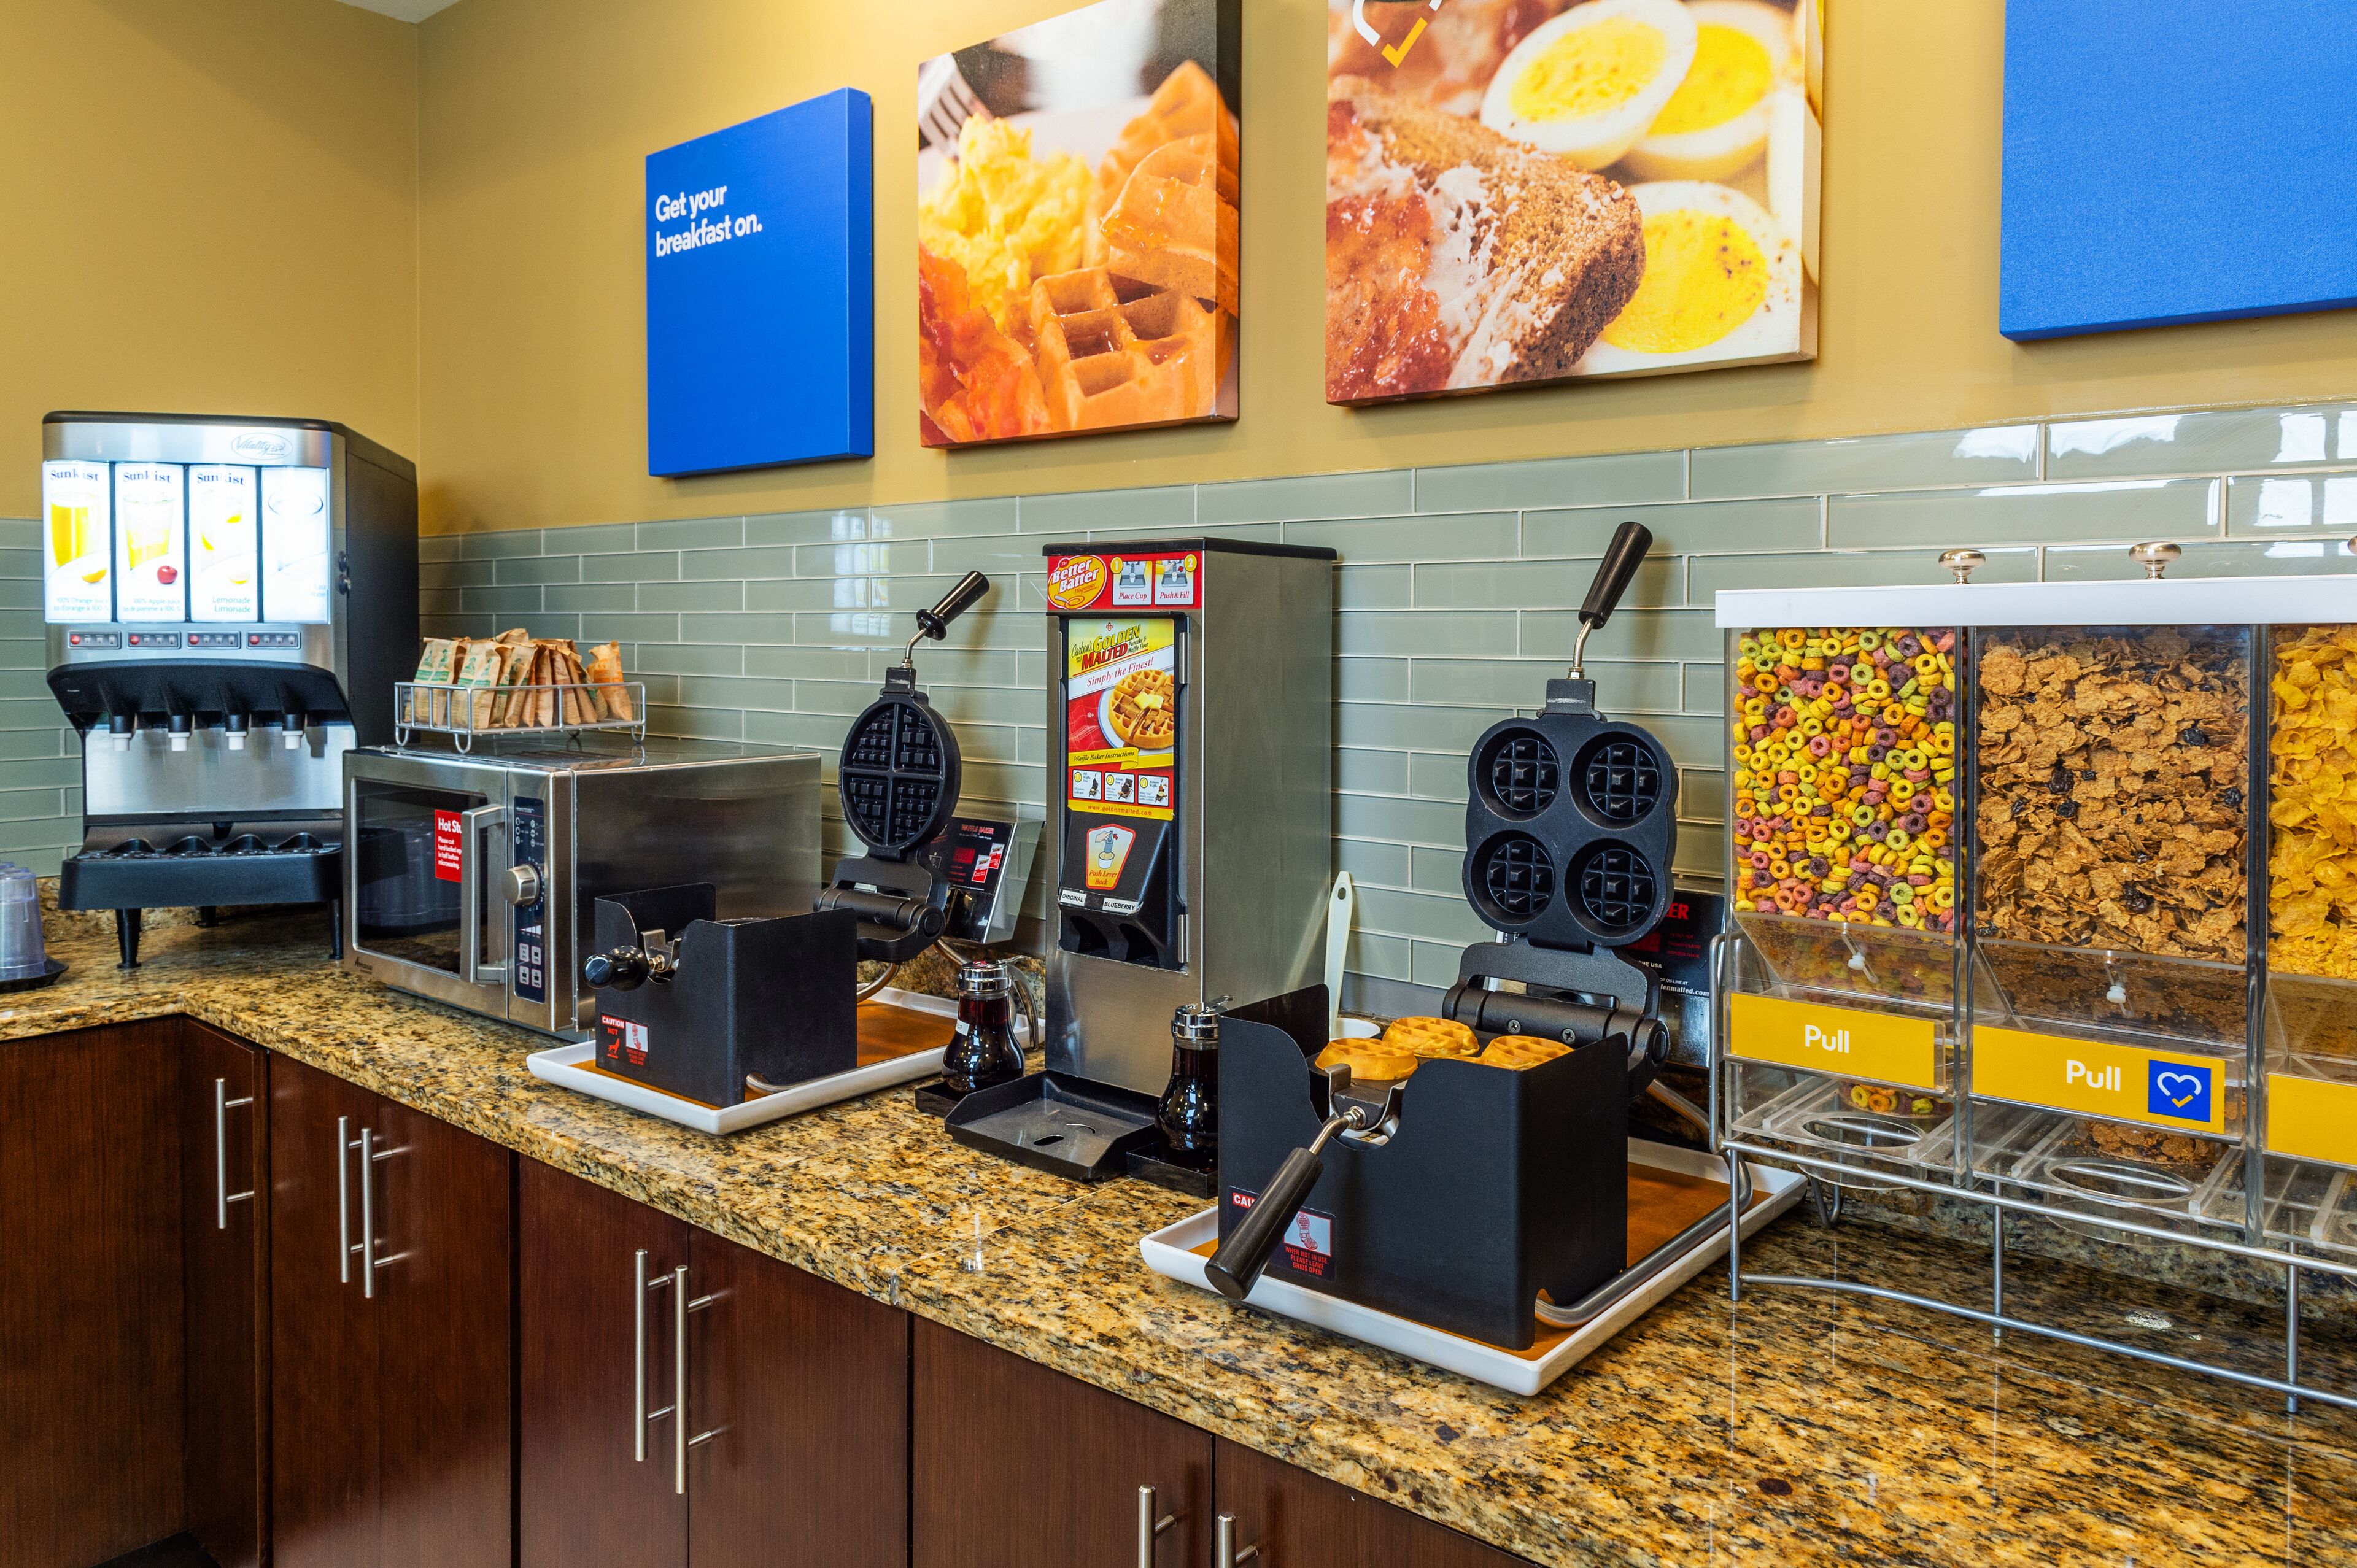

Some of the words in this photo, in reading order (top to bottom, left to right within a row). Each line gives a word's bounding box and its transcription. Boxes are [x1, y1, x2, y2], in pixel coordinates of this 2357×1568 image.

[655, 191, 687, 222] Get
[689, 185, 727, 219] your
[656, 215, 732, 257] breakfast
[734, 214, 763, 237] on.
[236, 436, 271, 456] Vitality
[196, 473, 244, 485] Sunist
[1115, 560, 1118, 570] 1
[1188, 558, 1193, 568] 2
[1051, 558, 1093, 584] Better
[1059, 568, 1099, 594] Batter
[1135, 592, 1147, 601] Cup
[214, 604, 252, 613] Limonade
[1071, 641, 1093, 658] Carbon's
[1093, 624, 1141, 653] GOLDEN
[1081, 643, 1129, 671] MALTED
[1087, 671, 1113, 687] Simply
[1114, 667, 1127, 678] the
[1128, 656, 1155, 673] Finest!
[1105, 751, 1135, 759] Instructions
[1088, 805, 1153, 816] www.goldenmalted.com
[438, 817, 451, 832] Hot
[452, 819, 462, 834] Stu
[1062, 894, 1084, 903] ORIGINAL
[1104, 901, 1136, 910] BLUEBERRY
[1666, 903, 1690, 920] ER
[602, 1016, 625, 1029] CAUTION
[1805, 1024, 1850, 1054] Pull
[2066, 1059, 2121, 1092] Pull
[1234, 1194, 1255, 1207] CAU
[1285, 1246, 1299, 1256] WHEN
[1290, 1254, 1309, 1265] PLEASE
[1309, 1260, 1324, 1270] LEAVE
[1292, 1262, 1308, 1272] GRIDS
[1309, 1267, 1322, 1276] OPEN
